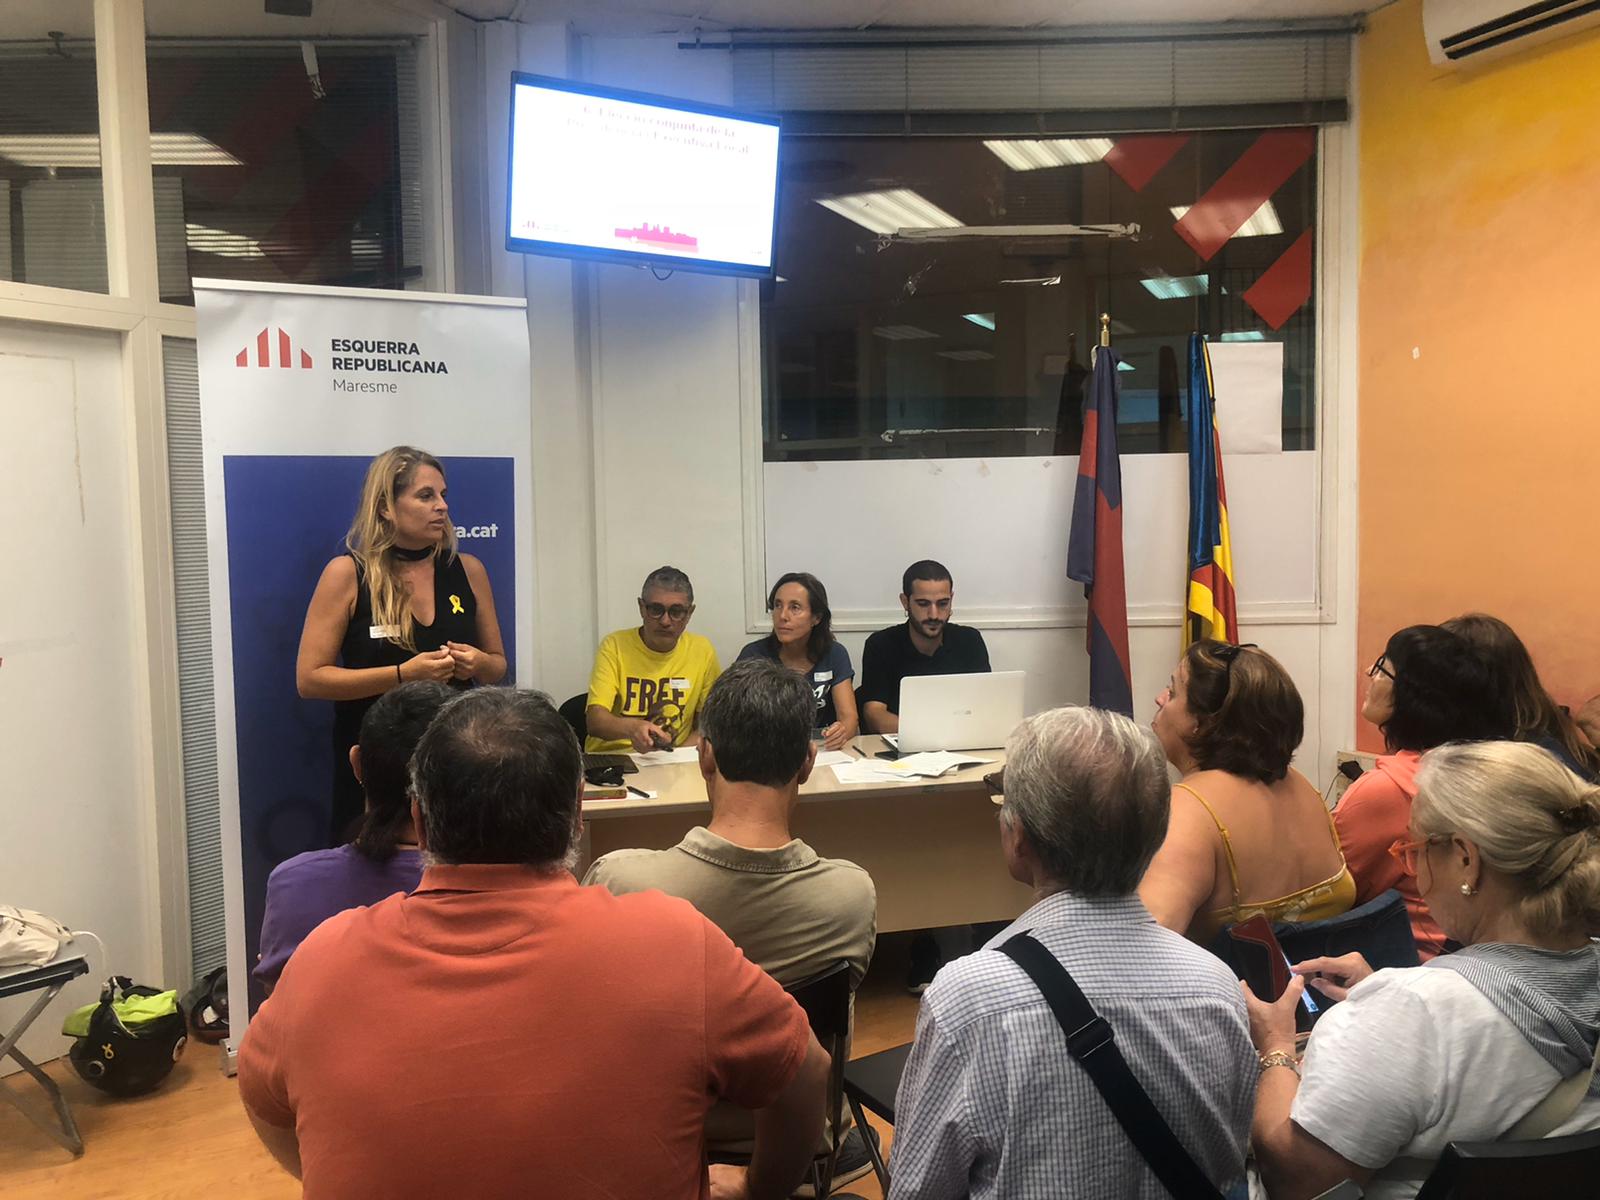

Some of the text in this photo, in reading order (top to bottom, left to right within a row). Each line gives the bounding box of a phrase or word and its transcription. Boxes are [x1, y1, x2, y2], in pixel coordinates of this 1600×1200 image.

[331, 338, 420, 355] ESQUERRA
[332, 357, 449, 374] REPUBLICANA
[333, 379, 398, 393] Maresme
[453, 523, 499, 538] a.cat
